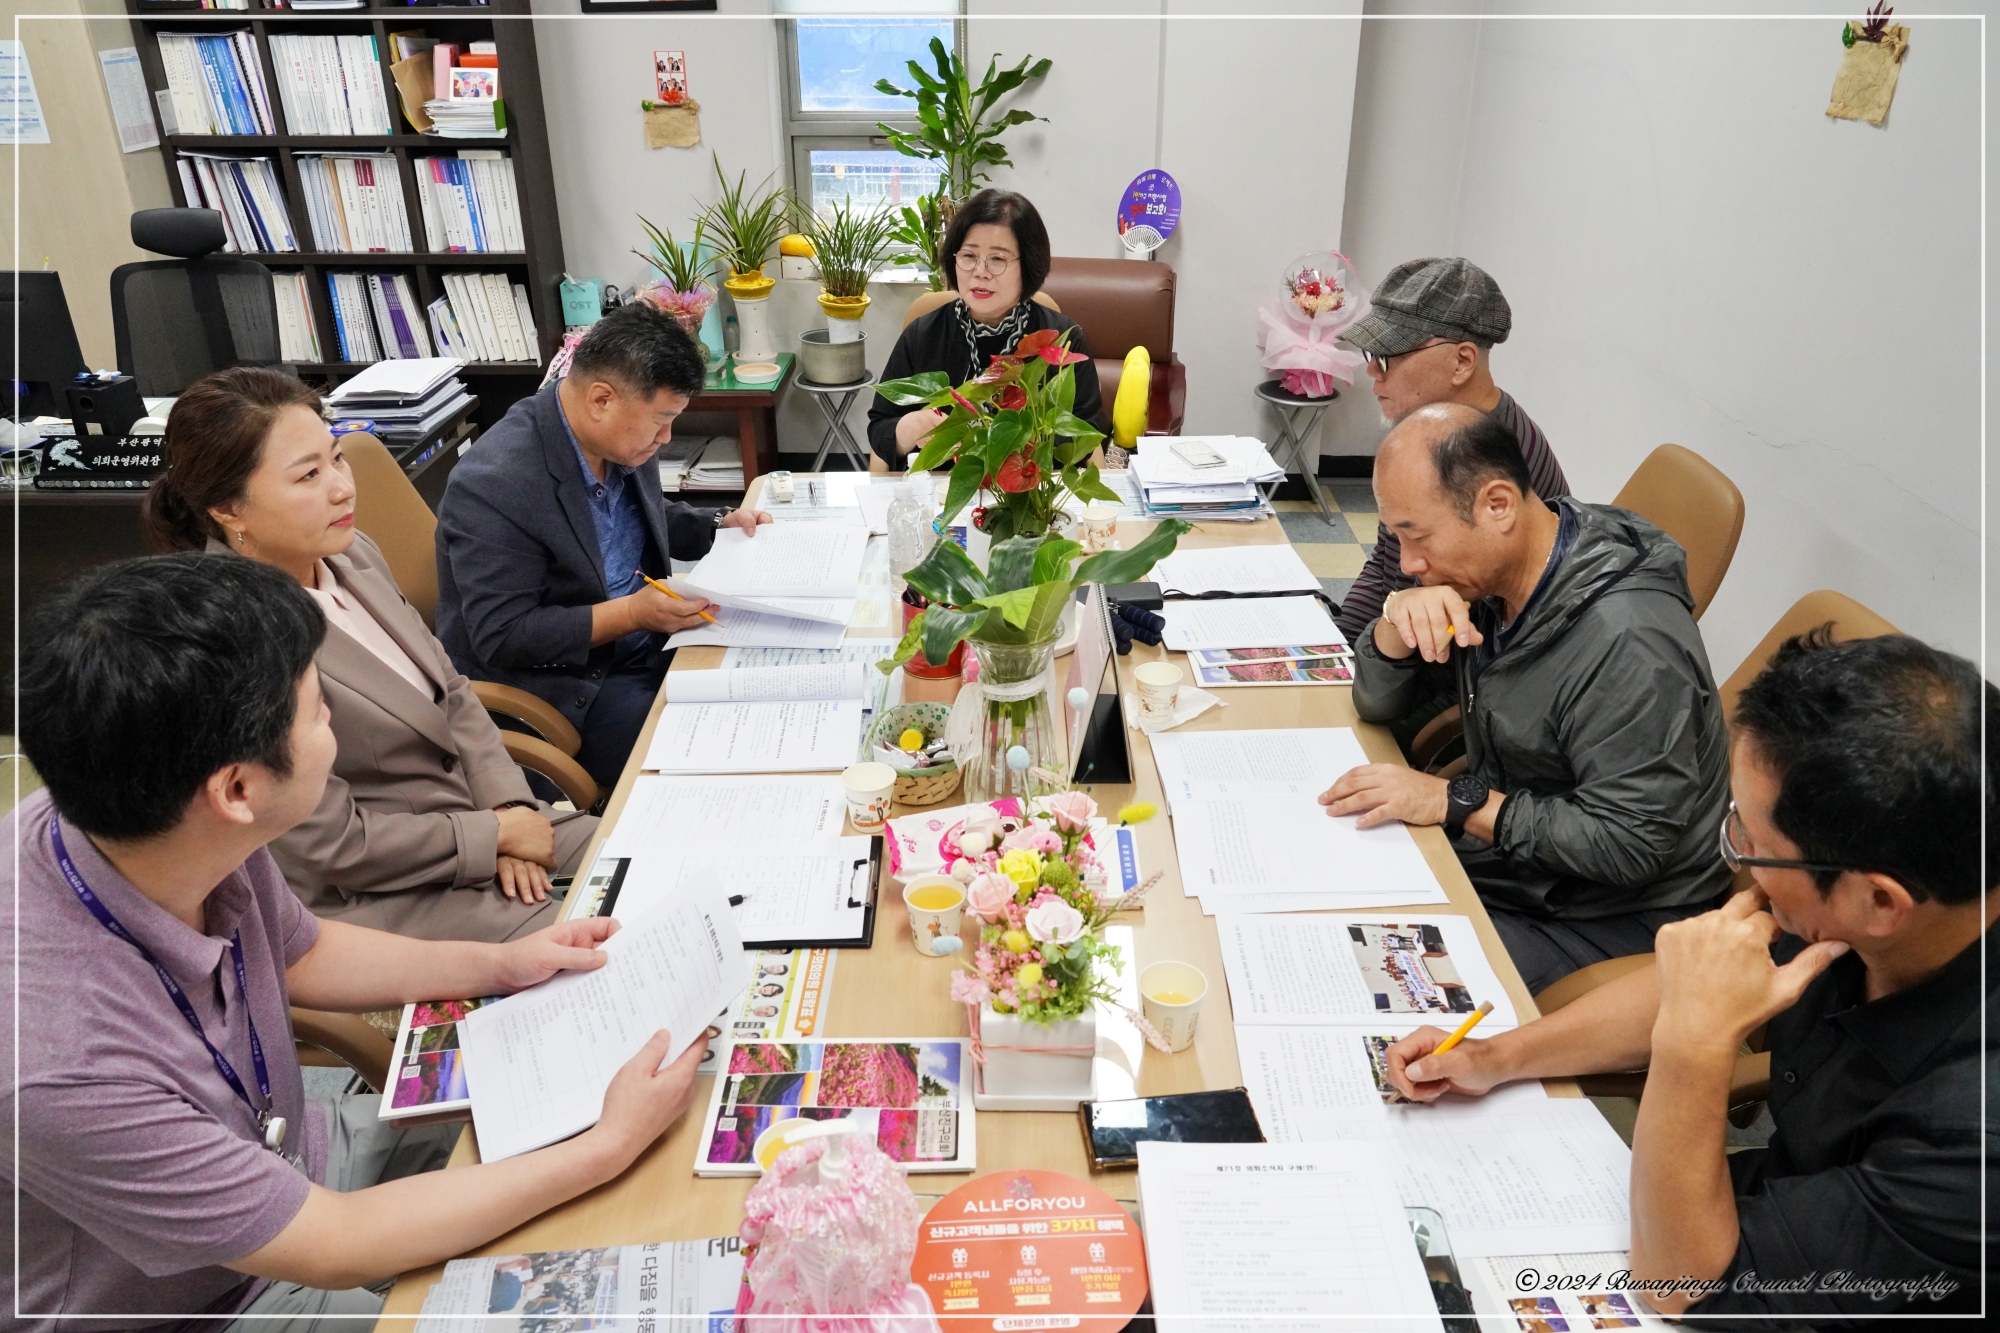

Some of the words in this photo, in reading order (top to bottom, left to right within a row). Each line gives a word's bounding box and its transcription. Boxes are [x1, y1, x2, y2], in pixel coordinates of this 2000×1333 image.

[117, 437, 168, 448] 부산광역
[92, 455, 162, 467] 의회운영위원장
[800, 989, 818, 1018] 일람표
[937, 1098, 951, 1154] 부산진구의회
[1216, 1165, 1241, 1173] 제71호
[963, 1196, 1086, 1214] ALLFORYOU
[930, 1223, 1020, 1239] 신규고객님들을
[1021, 1222, 1048, 1234] 위한
[1051, 1218, 1096, 1233] 3가지
[639, 1255, 658, 1303] 다짐을
